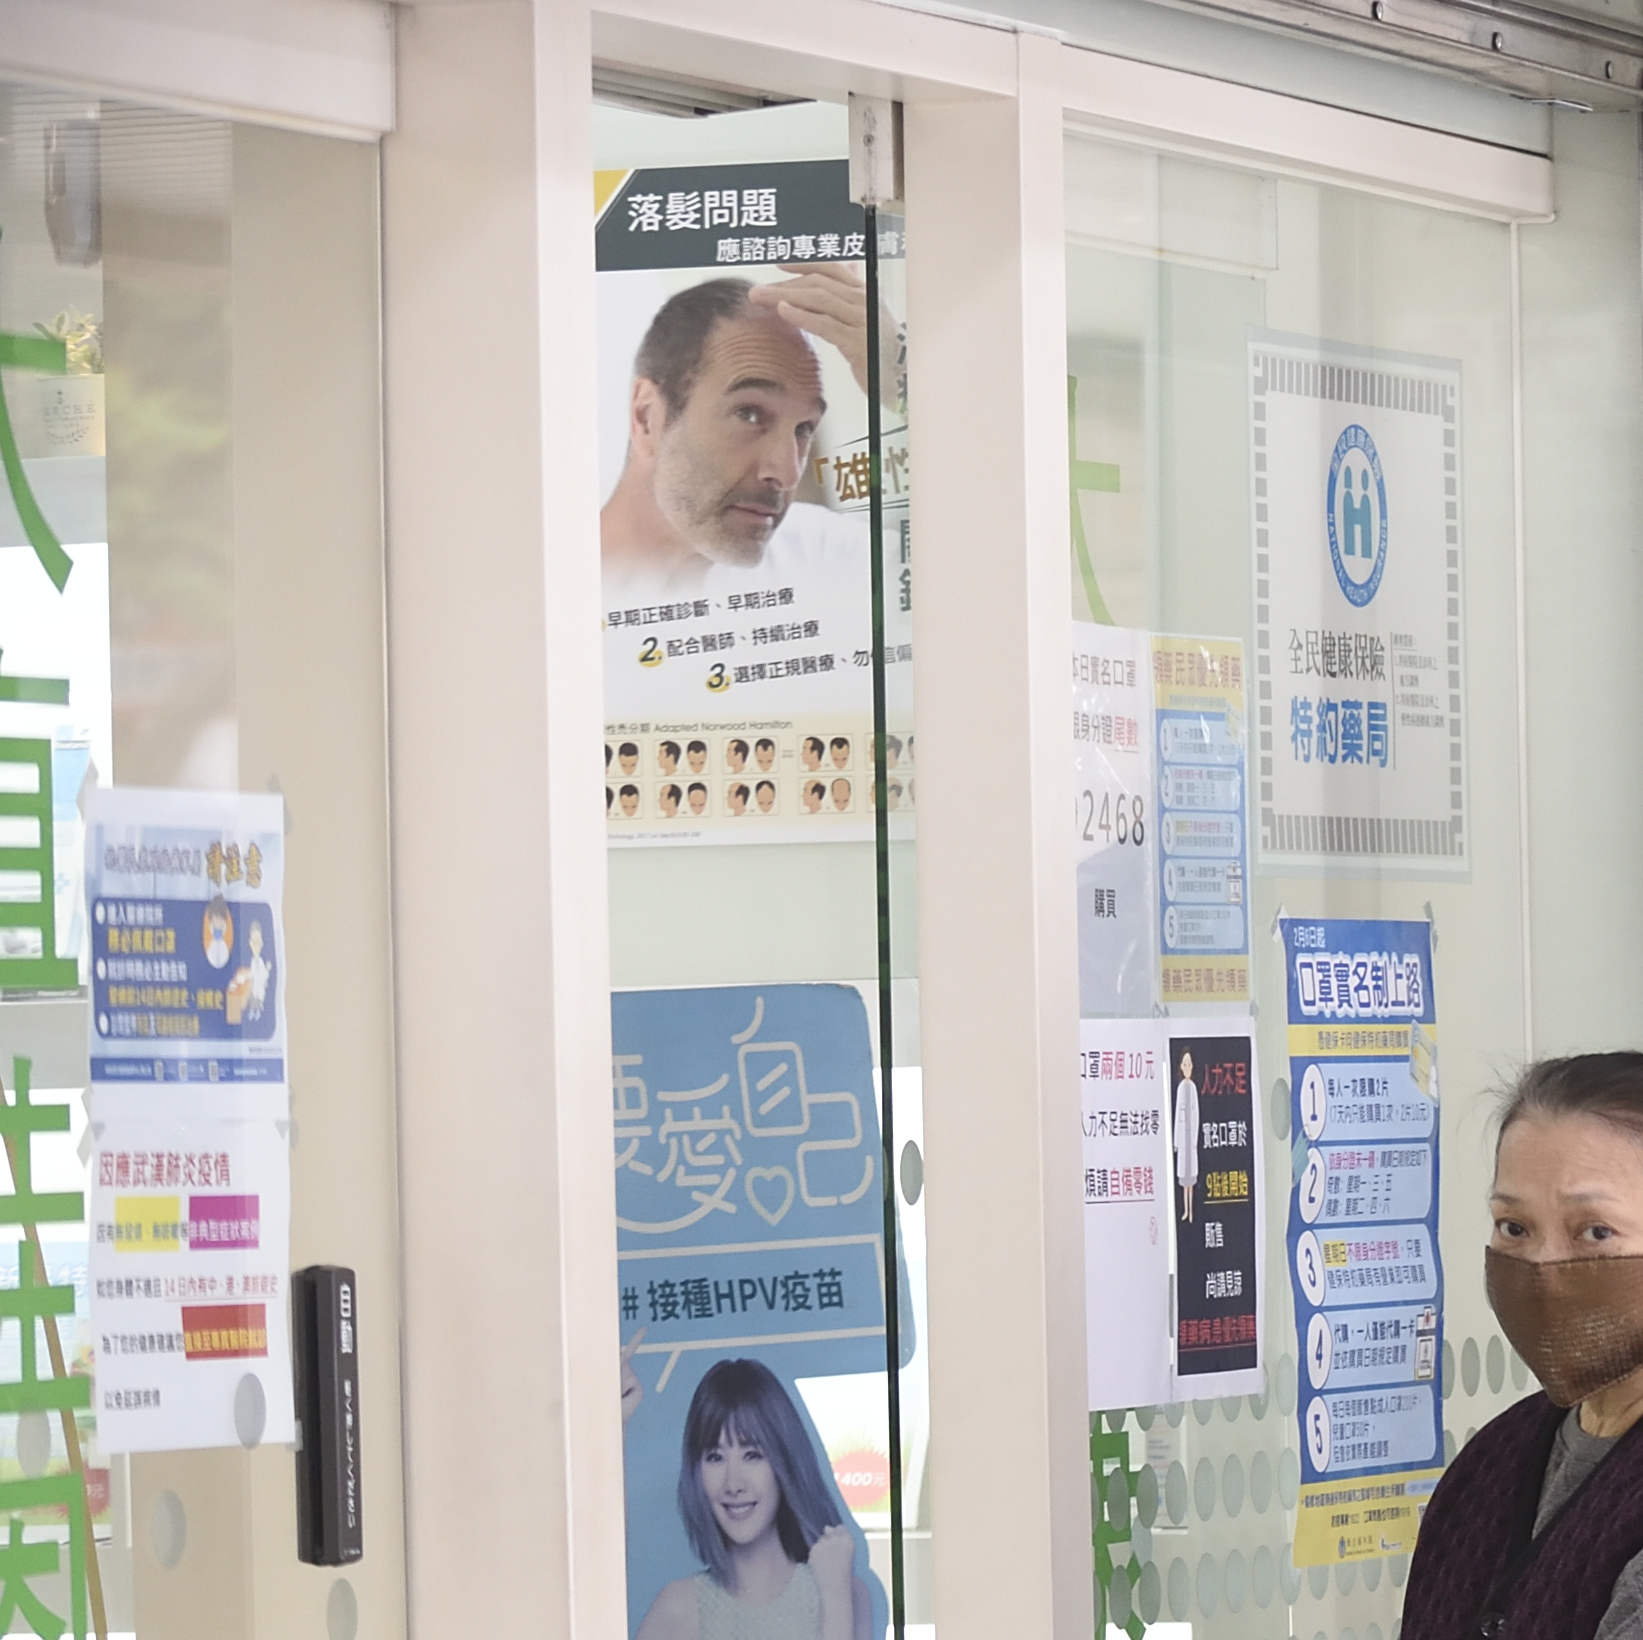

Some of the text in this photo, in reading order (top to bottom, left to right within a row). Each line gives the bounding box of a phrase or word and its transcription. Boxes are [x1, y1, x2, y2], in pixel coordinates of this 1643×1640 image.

[627, 188, 777, 233] 落髮問題
[608, 588, 794, 629] 早期正確診斷、早期治療
[639, 620, 820, 663] 2. 配合醫師、持續治療
[1289, 629, 1386, 681] 全民健康保險
[708, 662, 730, 689] 3.
[654, 723, 699, 733] Adapted
[1291, 695, 1388, 768] 特約藥局
[1075, 789, 1145, 847] 2468
[1094, 888, 1117, 918] 購買
[1297, 956, 1423, 1014] 口罩實名制上路
[1201, 1062, 1248, 1097] 人力不足
[1309, 1081, 1318, 1122] 1
[1202, 1121, 1248, 1149] 實名口罩於
[99, 1151, 231, 1189] 因應武漢肺炎疫情
[1085, 1166, 1155, 1198] 煩請自備零錢
[1205, 1170, 1249, 1199] 9點後開始
[1308, 1162, 1317, 1204] 2
[1205, 1222, 1224, 1249] 販售
[1205, 1270, 1242, 1299] 尚請見諒
[1306, 1247, 1316, 1288] 3
[647, 1267, 844, 1323] 接種HPV疫苗
[1315, 1329, 1323, 1369] 4
[1314, 1413, 1323, 1455] 5
